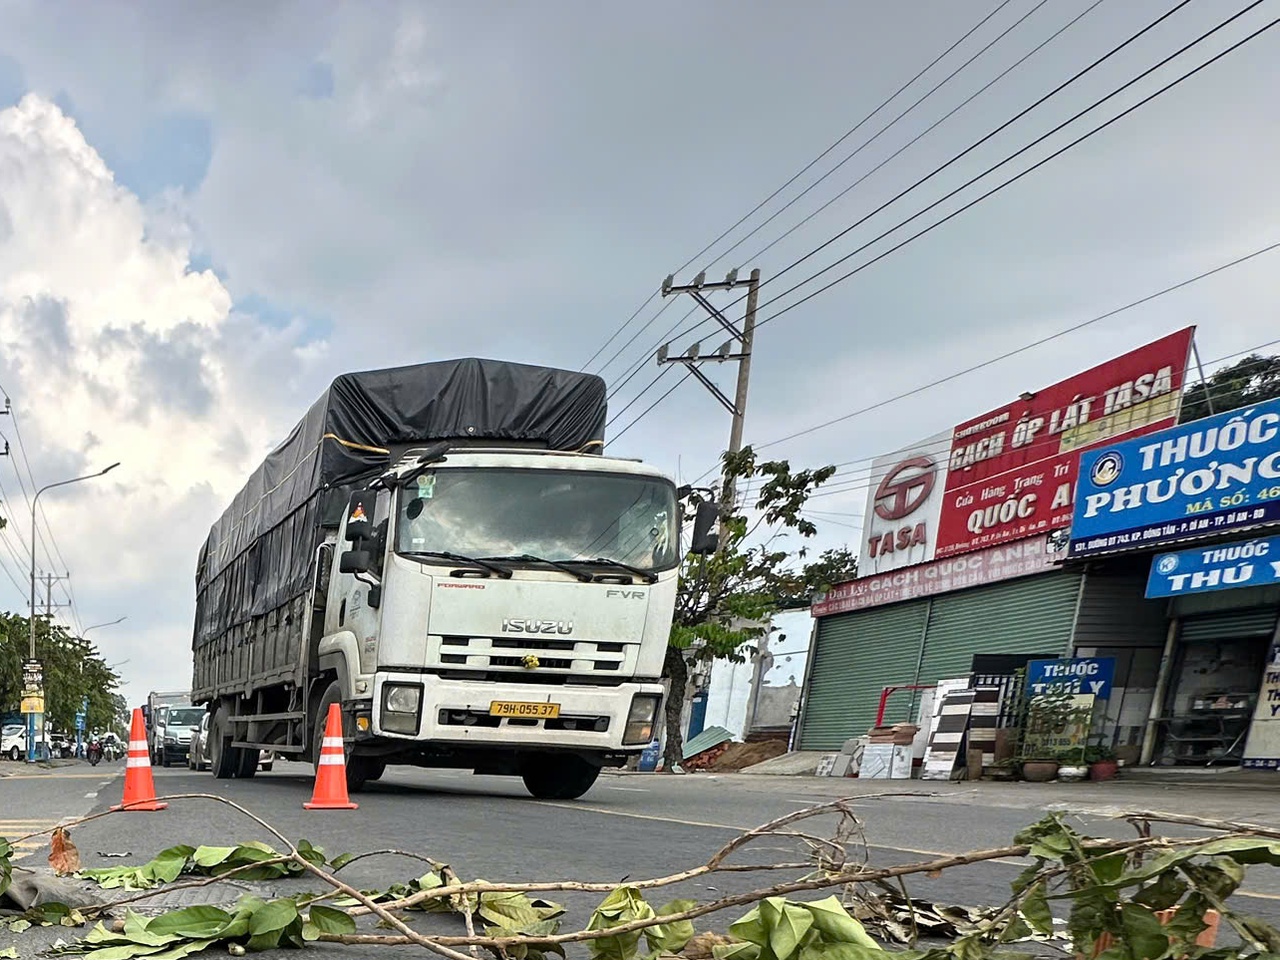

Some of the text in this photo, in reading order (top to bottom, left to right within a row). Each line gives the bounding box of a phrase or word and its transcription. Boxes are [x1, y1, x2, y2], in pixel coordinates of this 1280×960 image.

[1048, 393, 1096, 435] LÁT
[1103, 365, 1173, 416] TASA
[1139, 409, 1279, 471] THUỐC
[967, 489, 1037, 534] QUỐC
[868, 523, 927, 559] TASA
[1202, 540, 1270, 564] THUỐC
[869, 569, 919, 592] GẠCH
[923, 552, 983, 579] QUỐC
[989, 540, 1042, 565] ANH
[1167, 561, 1254, 592] THÚ
[606, 589, 645, 600] FVR
[501, 618, 574, 635] ISUZU
